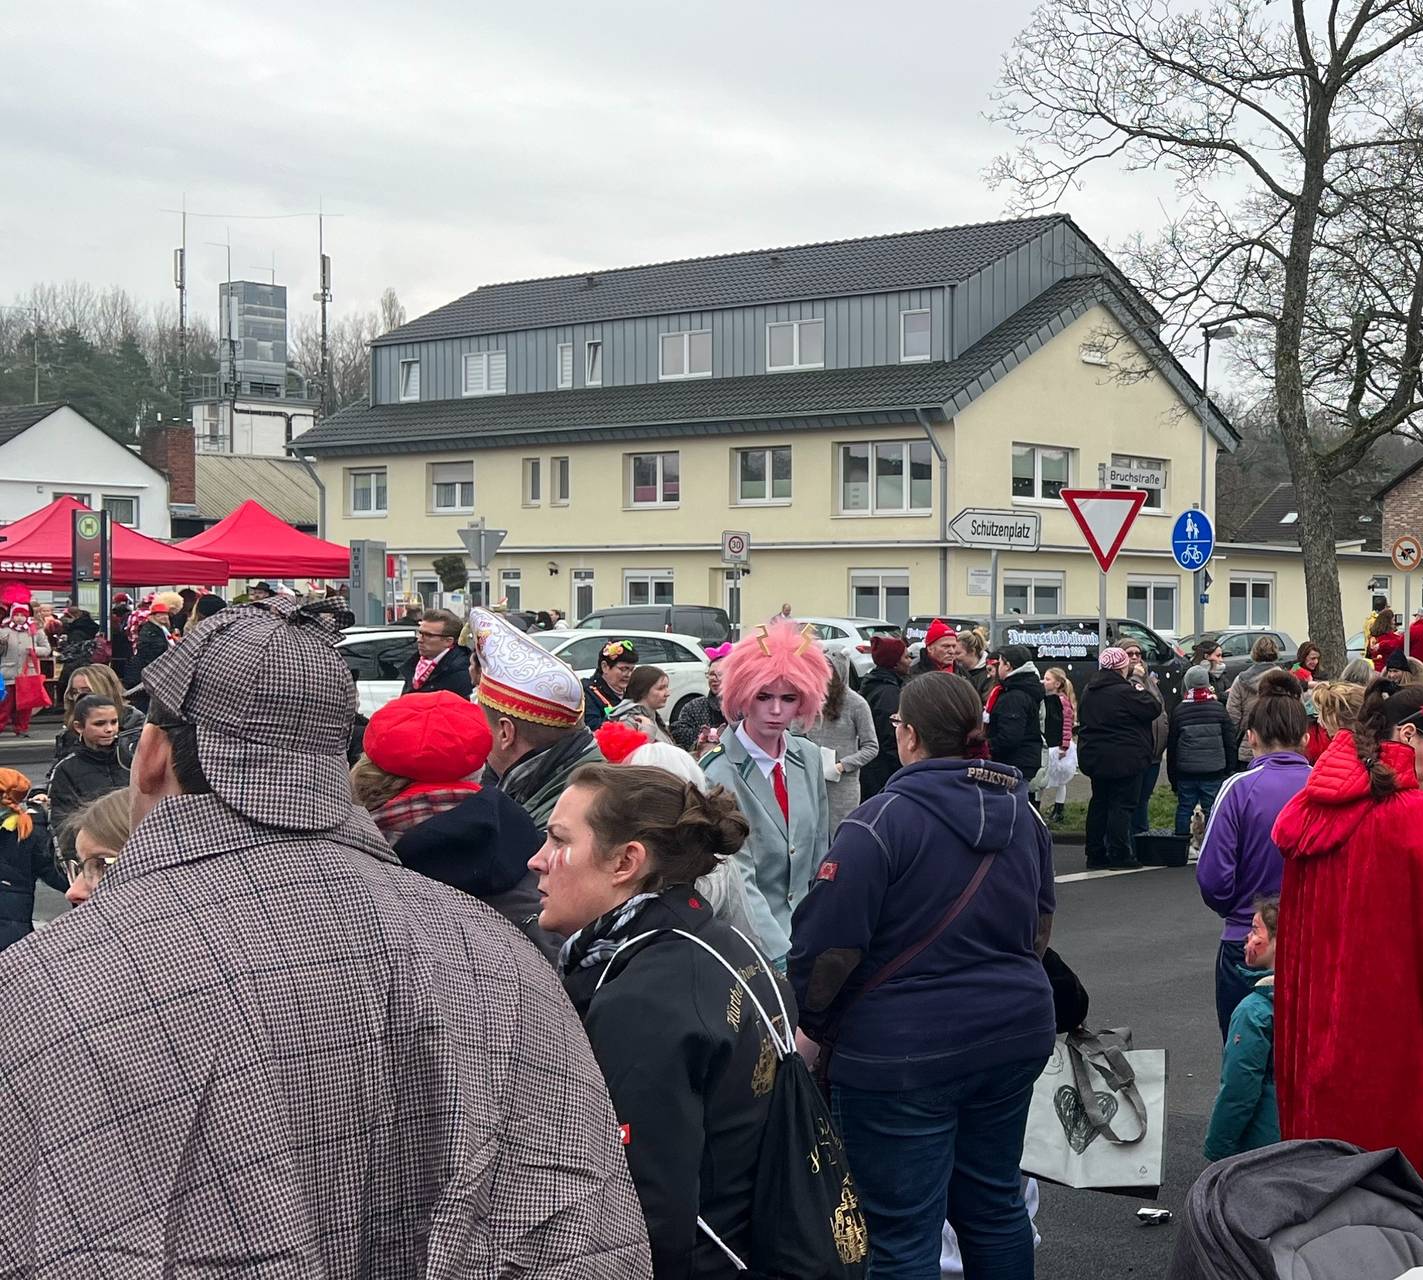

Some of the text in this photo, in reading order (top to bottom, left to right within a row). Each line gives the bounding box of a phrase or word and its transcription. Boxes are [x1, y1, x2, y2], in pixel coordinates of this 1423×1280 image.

[1110, 470, 1160, 485] Bruchstraße
[971, 519, 1031, 542] Schützenplatz
[731, 540, 741, 550] 30
[0, 561, 53, 575] REWE
